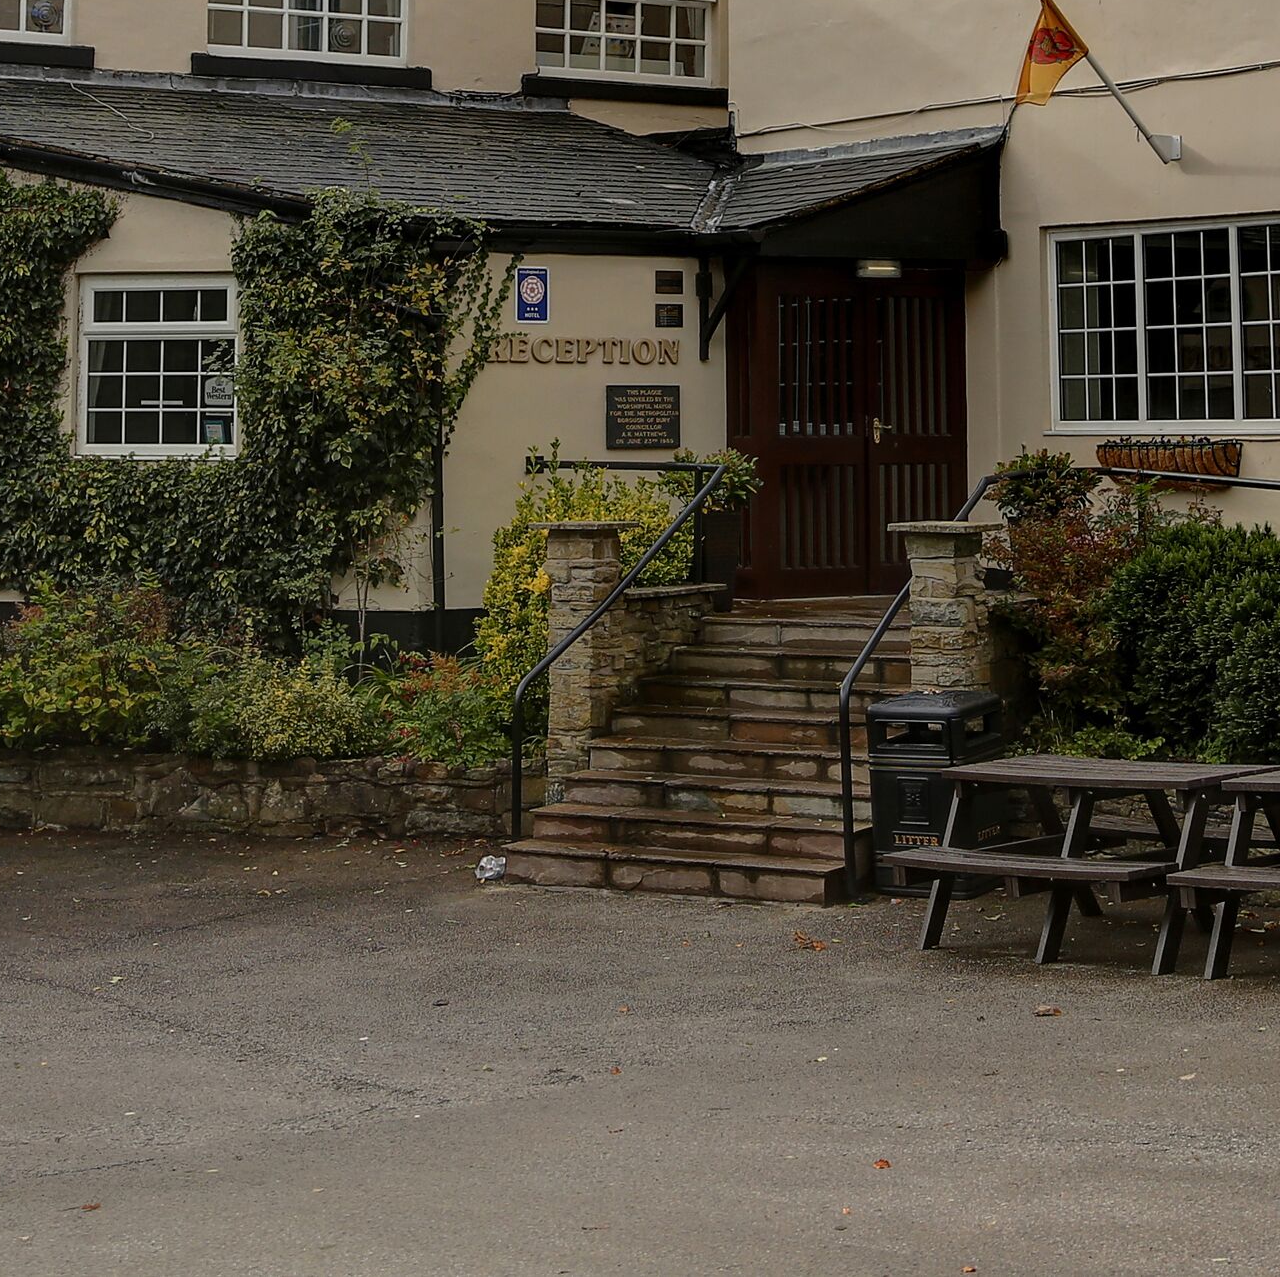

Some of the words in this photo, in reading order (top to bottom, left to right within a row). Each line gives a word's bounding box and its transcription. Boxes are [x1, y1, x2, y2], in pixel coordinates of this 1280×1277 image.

[486, 337, 680, 365] RECEPTION
[206, 392, 232, 400] Western
[894, 834, 939, 845] LITTER
